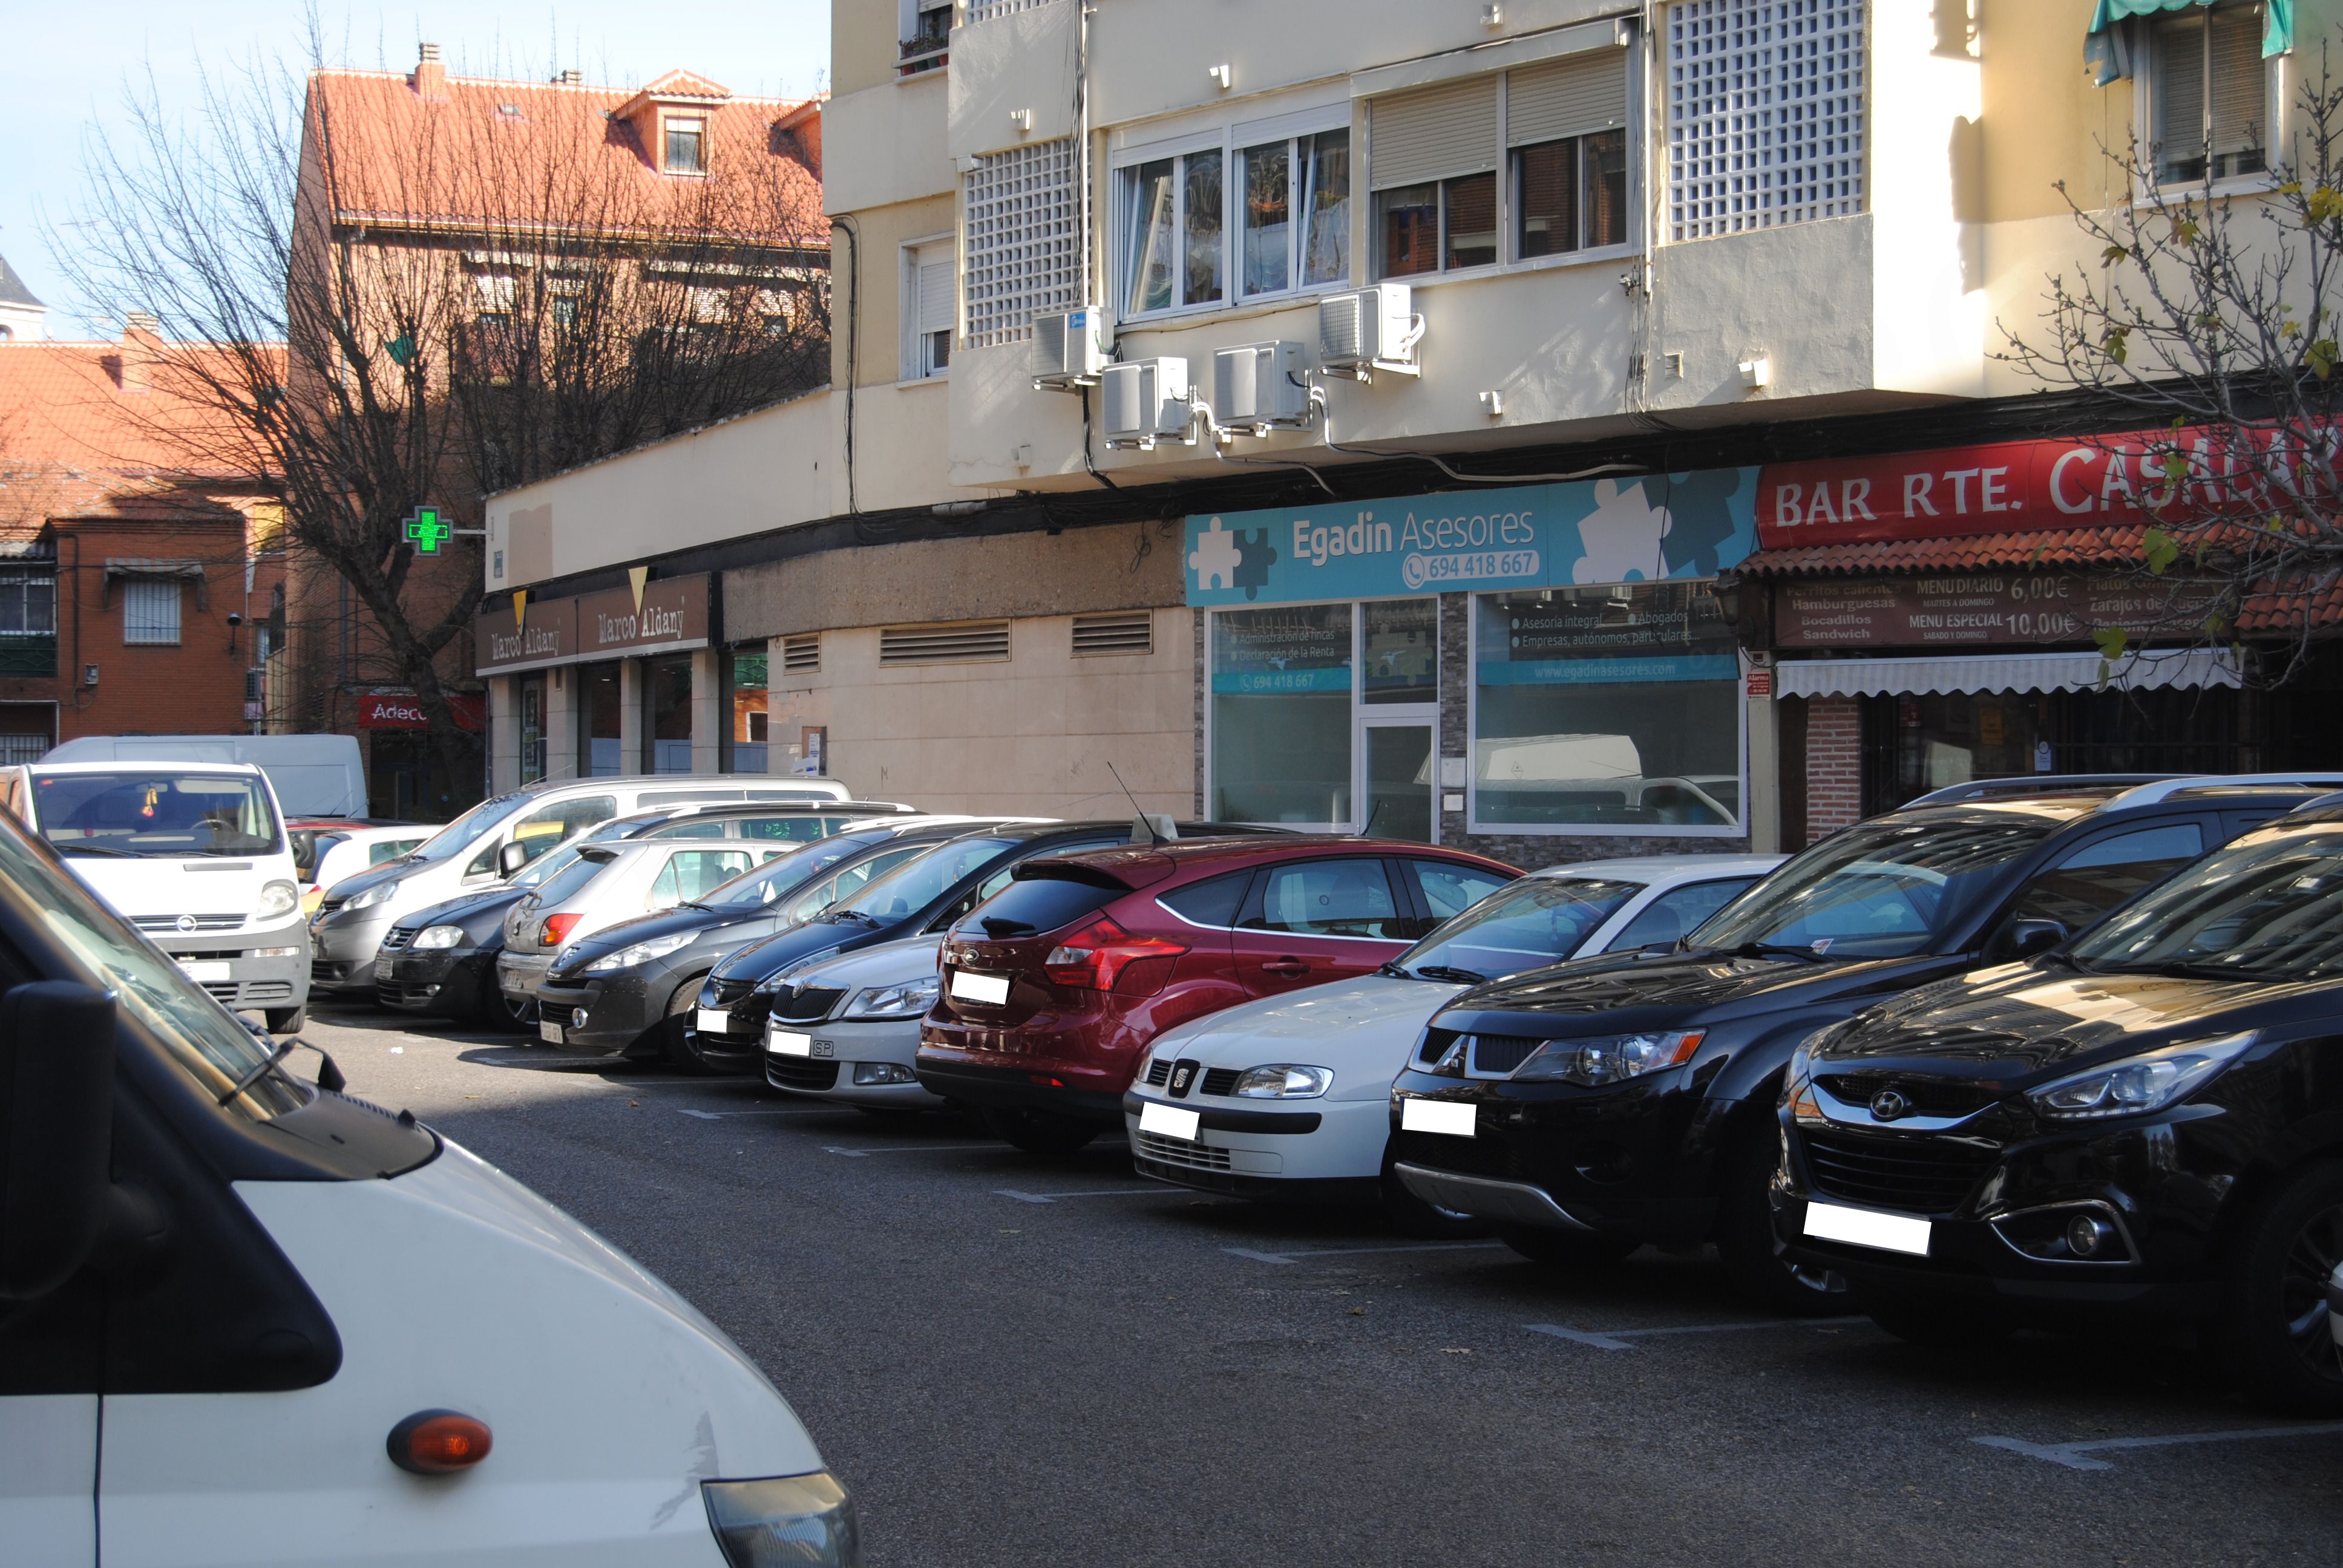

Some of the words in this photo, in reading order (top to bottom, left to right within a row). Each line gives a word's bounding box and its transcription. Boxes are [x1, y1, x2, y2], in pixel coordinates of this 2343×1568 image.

[1775, 477, 1878, 528] BAR
[1903, 466, 2023, 518] RTE.
[1293, 512, 1392, 567] Egadin
[1400, 512, 1534, 550] Asesores
[1429, 557, 1459, 578] 694
[1465, 554, 1495, 576] 418
[1501, 552, 1533, 574] 667
[1786, 585, 1839, 596] Perritos
[1843, 584, 1901, 595] calientes
[1916, 580, 1954, 594] MENU
[1956, 578, 2004, 593] DIARIO
[2011, 576, 2069, 603] 6,00€
[1792, 598, 1896, 612] Hamburguesas
[1959, 598, 1994, 606] DOMINGO
[598, 614, 636, 644] Marco
[642, 606, 684, 639] Aldany
[1522, 615, 1563, 629] Asesoría
[1565, 613, 1602, 629] integral
[1639, 610, 1688, 626] Abogados
[1801, 614, 1872, 626] Bocadillos
[1909, 615, 1943, 628] MENU
[1947, 613, 2003, 627] ESPECIAL
[2005, 613, 2076, 639] 10,00€
[1299, 630, 1309, 641] de
[1522, 634, 1570, 648] Empresas,
[1573, 632, 1630, 645] autónomos,
[1803, 629, 1870, 639] Sandwich
[1956, 630, 1987, 639] DOMINGO
[492, 633, 521, 660] Marco
[525, 627, 560, 656] Aldany
[1240, 647, 1286, 661] Declaración
[1288, 648, 1298, 658] de
[1301, 647, 1308, 658] la
[1309, 646, 1334, 657] Renta
[1535, 663, 1675, 679] www.egadinasesores.com
[1253, 676, 1271, 688] 694
[1274, 675, 1293, 687] 418
[1296, 674, 1314, 687] 667
[816, 1042, 831, 1054] SP
